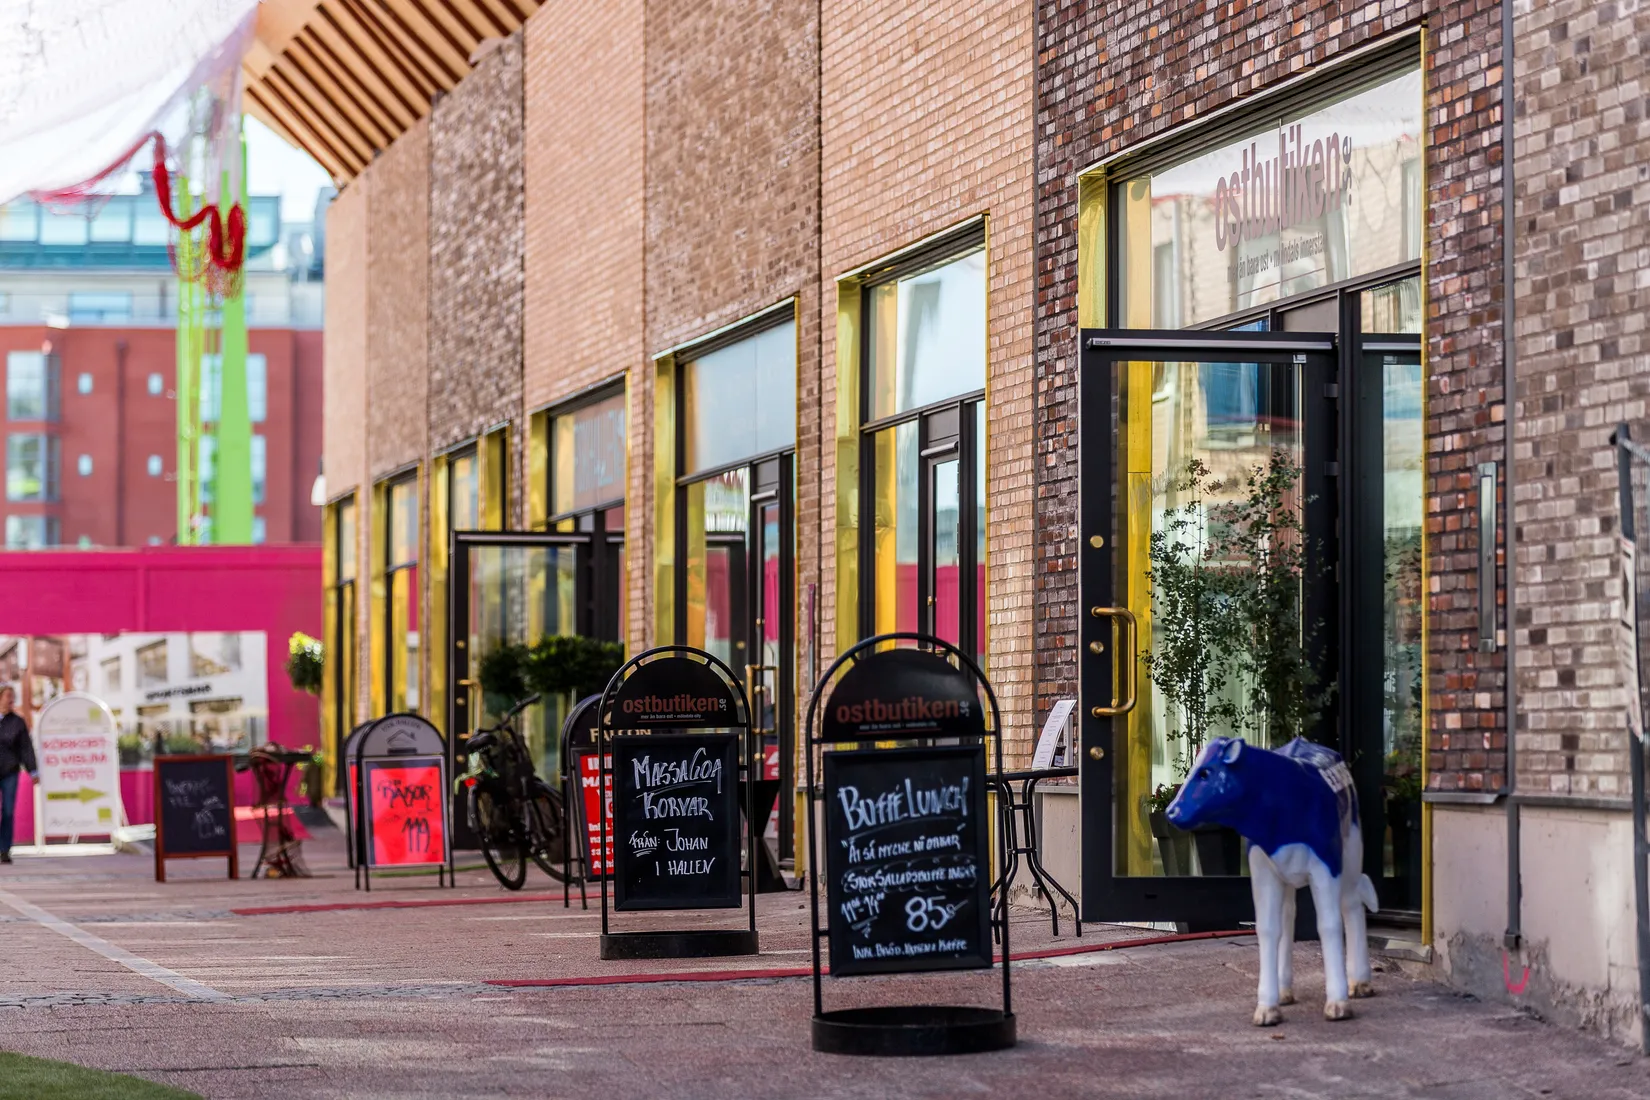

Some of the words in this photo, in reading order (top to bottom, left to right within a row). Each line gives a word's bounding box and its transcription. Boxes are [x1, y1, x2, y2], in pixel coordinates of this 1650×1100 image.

[1215, 124, 1340, 251] ostbutiken
[1247, 253, 1260, 277] bara
[1260, 248, 1269, 272] ost
[1273, 238, 1299, 268] mlndals
[623, 694, 718, 713] ostbutiken
[836, 697, 959, 723] ostbutiken
[643, 791, 714, 820] KORVAR
[664, 828, 709, 851] JOHAN
[668, 857, 716, 876] HALLEN
